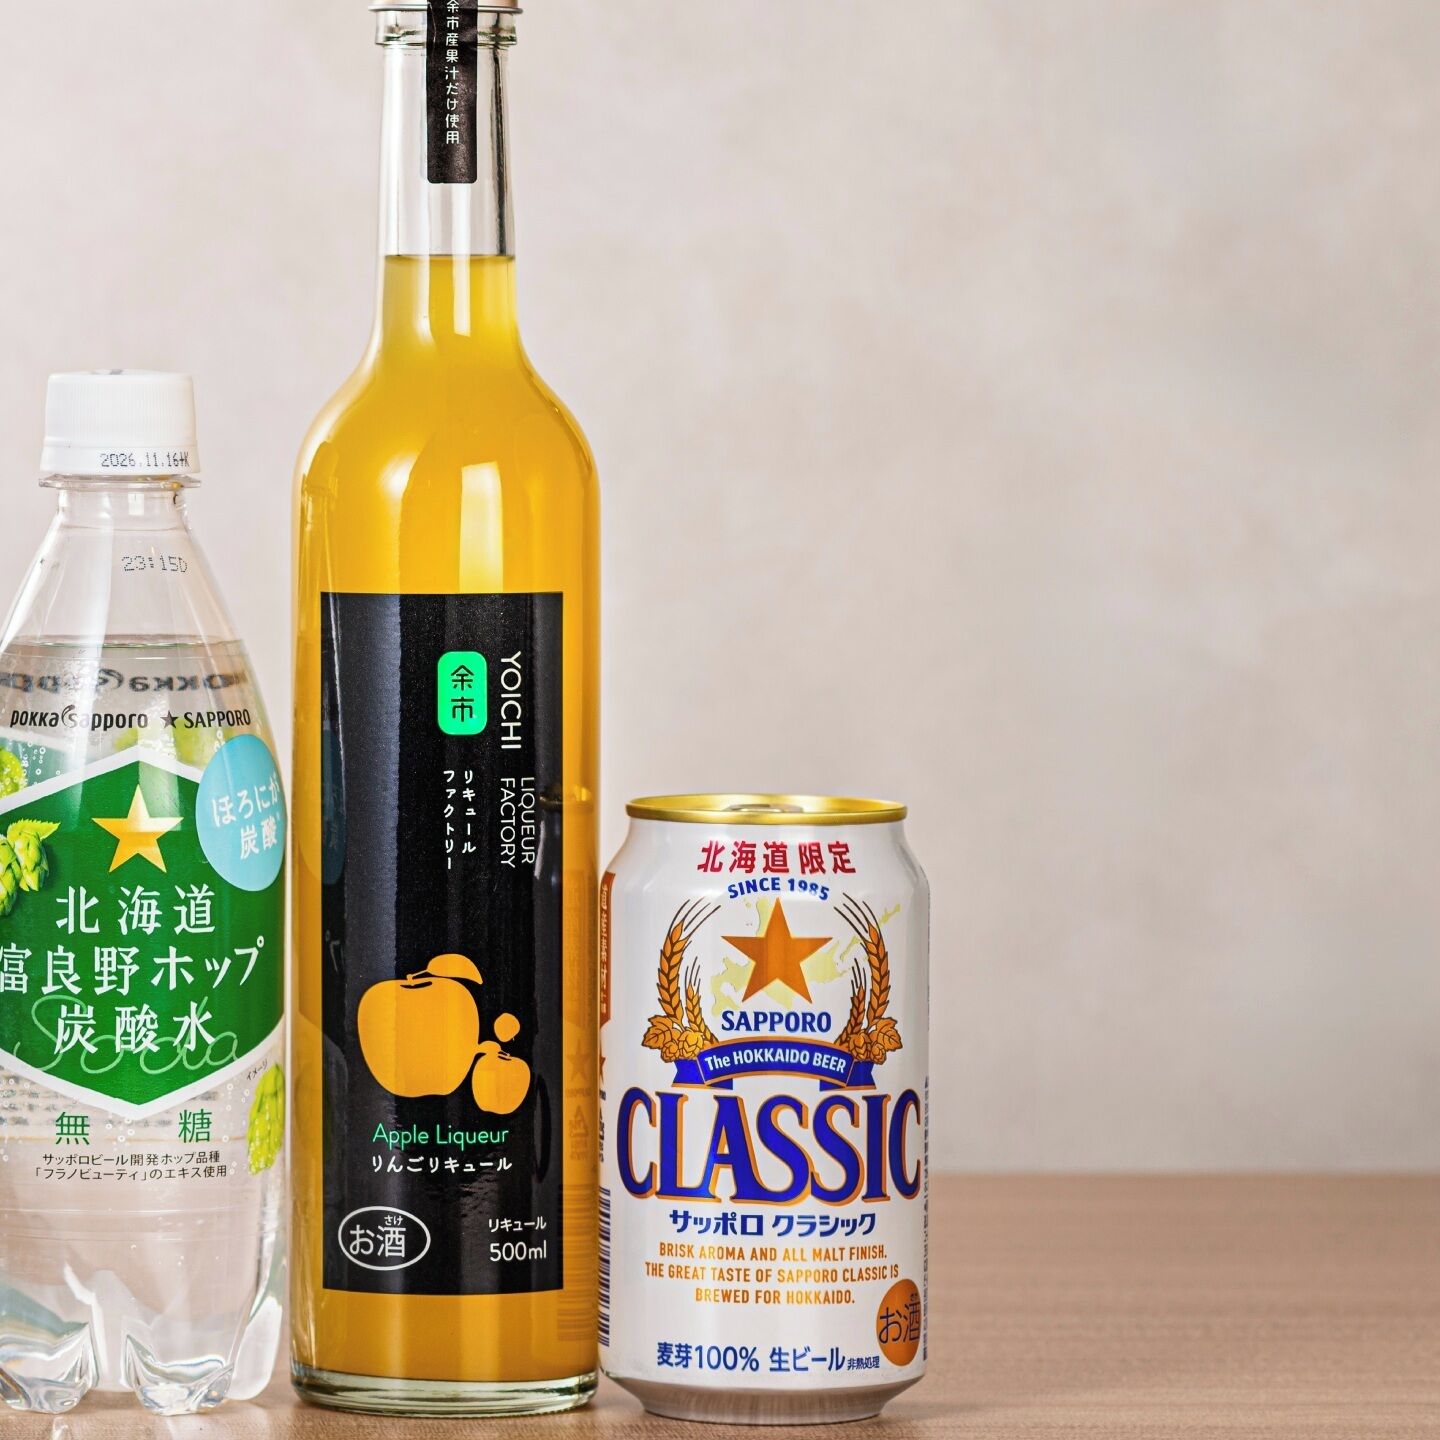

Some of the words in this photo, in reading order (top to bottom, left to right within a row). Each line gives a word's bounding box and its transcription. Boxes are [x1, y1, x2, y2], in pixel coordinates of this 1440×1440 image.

[444, 0, 461, 145] 余市産果汁だけ使用
[450, 664, 475, 723] 余市
[500, 651, 522, 749] YOICHI
[183, 709, 252, 729] SAPPORO
[212, 770, 280, 827] ほろにが
[462, 770, 477, 854] リキュール
[443, 770, 455, 870] ファクトリー
[500, 777, 516, 869] FACTORY
[519, 777, 535, 864] LIQUEUR
[727, 876, 781, 899] SINCE
[787, 877, 830, 901] 1985
[55, 883, 216, 936] 北海道
[54, 1001, 216, 1055] 炭酸水
[721, 1010, 832, 1033] SAPPORO
[704, 1055, 731, 1072] The
[732, 1048, 810, 1065] HOKKAIDO
[812, 1051, 847, 1074] BEER
[372, 1123, 429, 1151] Apple
[436, 1123, 509, 1151] Liqueur
[616, 1086, 922, 1207] CLASSIC
[42, 1151, 220, 1167] サッポロビール開発ホップ品種
[371, 1155, 513, 1174] りんごリキュール
[35, 1165, 227, 1182] 「フラノビューティ」のエキス使用
[384, 1215, 403, 1226] さけ
[488, 1216, 547, 1233] リキュール
[669, 1210, 763, 1237] サッポロ
[772, 1212, 876, 1238] クラシック
[349, 1224, 407, 1258] お酒
[489, 1240, 547, 1262] 500ml
[660, 1242, 695, 1259] BRISK
[699, 1245, 746, 1261] AROMA
[750, 1247, 778, 1262] AND
[782, 1247, 807, 1262] ALL
[812, 1246, 846, 1262] MALT
[849, 1244, 888, 1261] FINISH.
[645, 1261, 665, 1278] THE
[668, 1264, 707, 1281] GREAT
[710, 1266, 751, 1283] TASTE
[755, 1268, 773, 1284] OF
[777, 1268, 838, 1284] SAPPORO
[842, 1265, 888, 1284] CLASSIC
[890, 1263, 900, 1279] IS
[695, 1287, 750, 1304] BREWED
[755, 1289, 781, 1304] FOR
[786, 1289, 856, 1305] HOKKAIDO.
[878, 1301, 921, 1344] お酒
[657, 1341, 760, 1373] 麦芽100%
[769, 1345, 846, 1373] 生ビール
